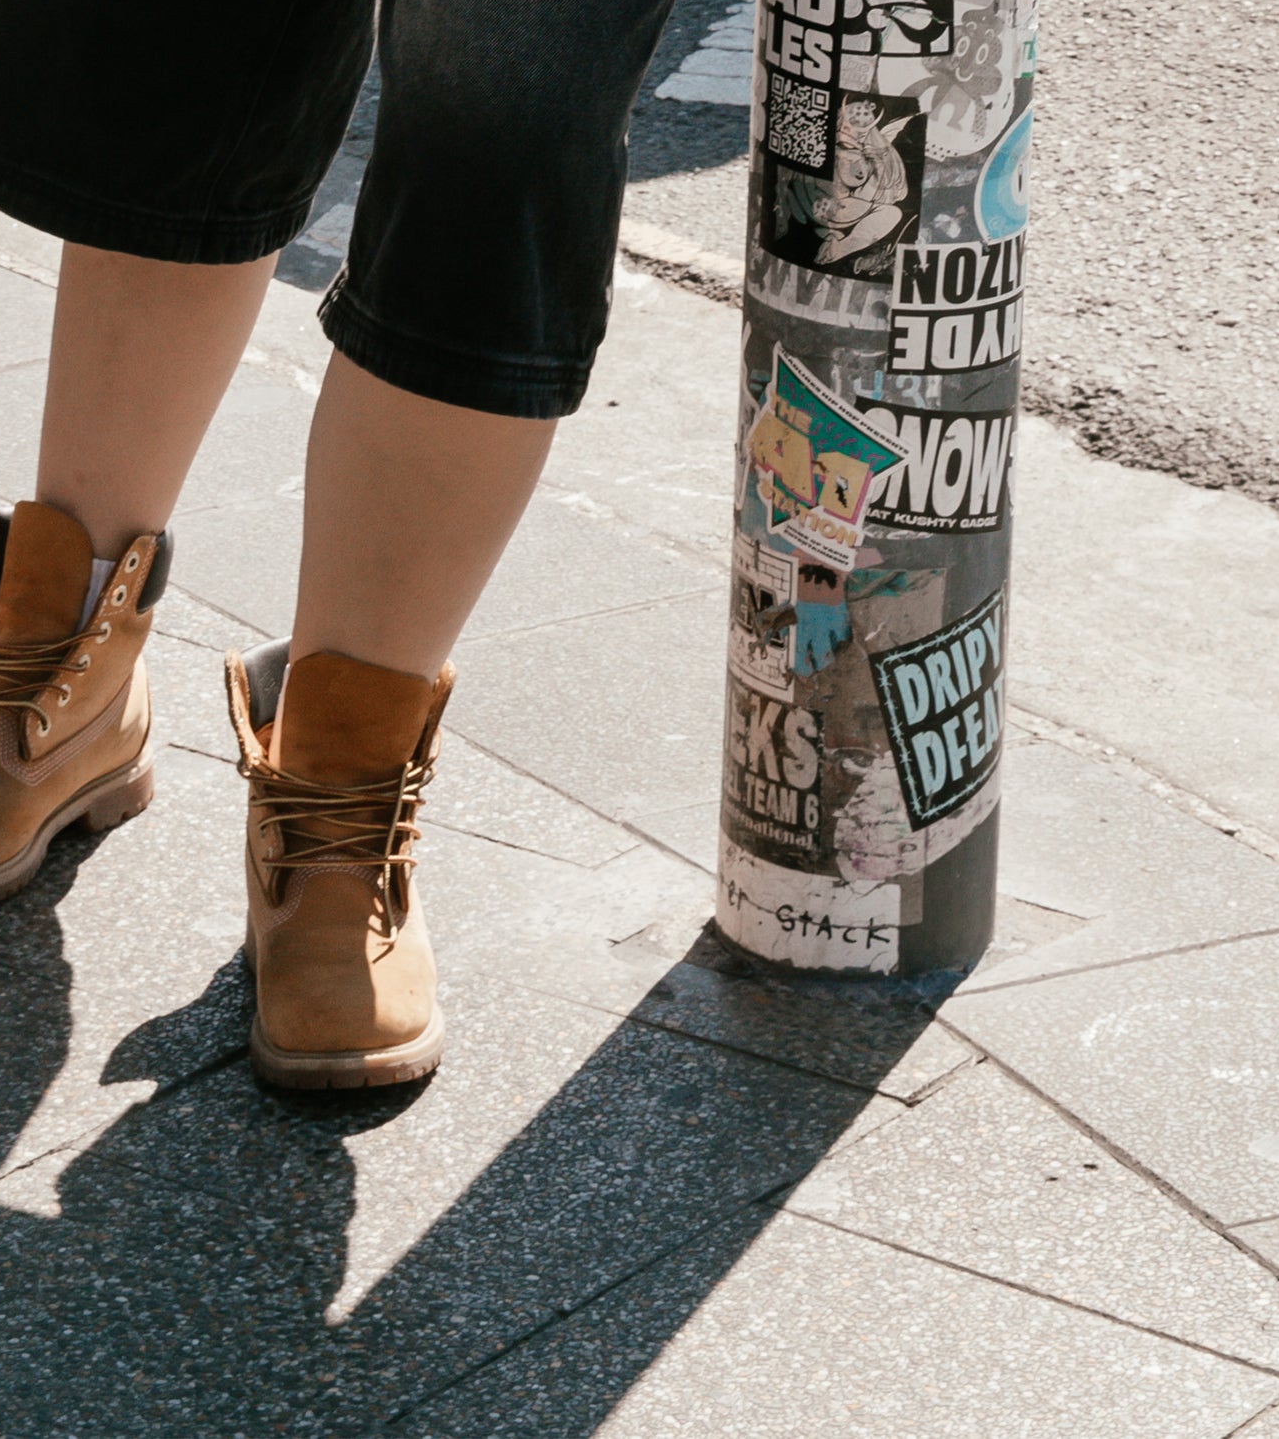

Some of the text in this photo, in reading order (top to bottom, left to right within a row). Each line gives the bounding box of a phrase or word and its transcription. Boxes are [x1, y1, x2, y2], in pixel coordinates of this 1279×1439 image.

[891, 297, 1021, 371] HYDE
[821, 391, 838, 407] HIP
[838, 406, 859, 423] HOP
[894, 514, 957, 529] KUSHTY
[960, 516, 998, 529] GADGE
[744, 774, 798, 826] TEAM
[804, 793, 820, 830] 6
